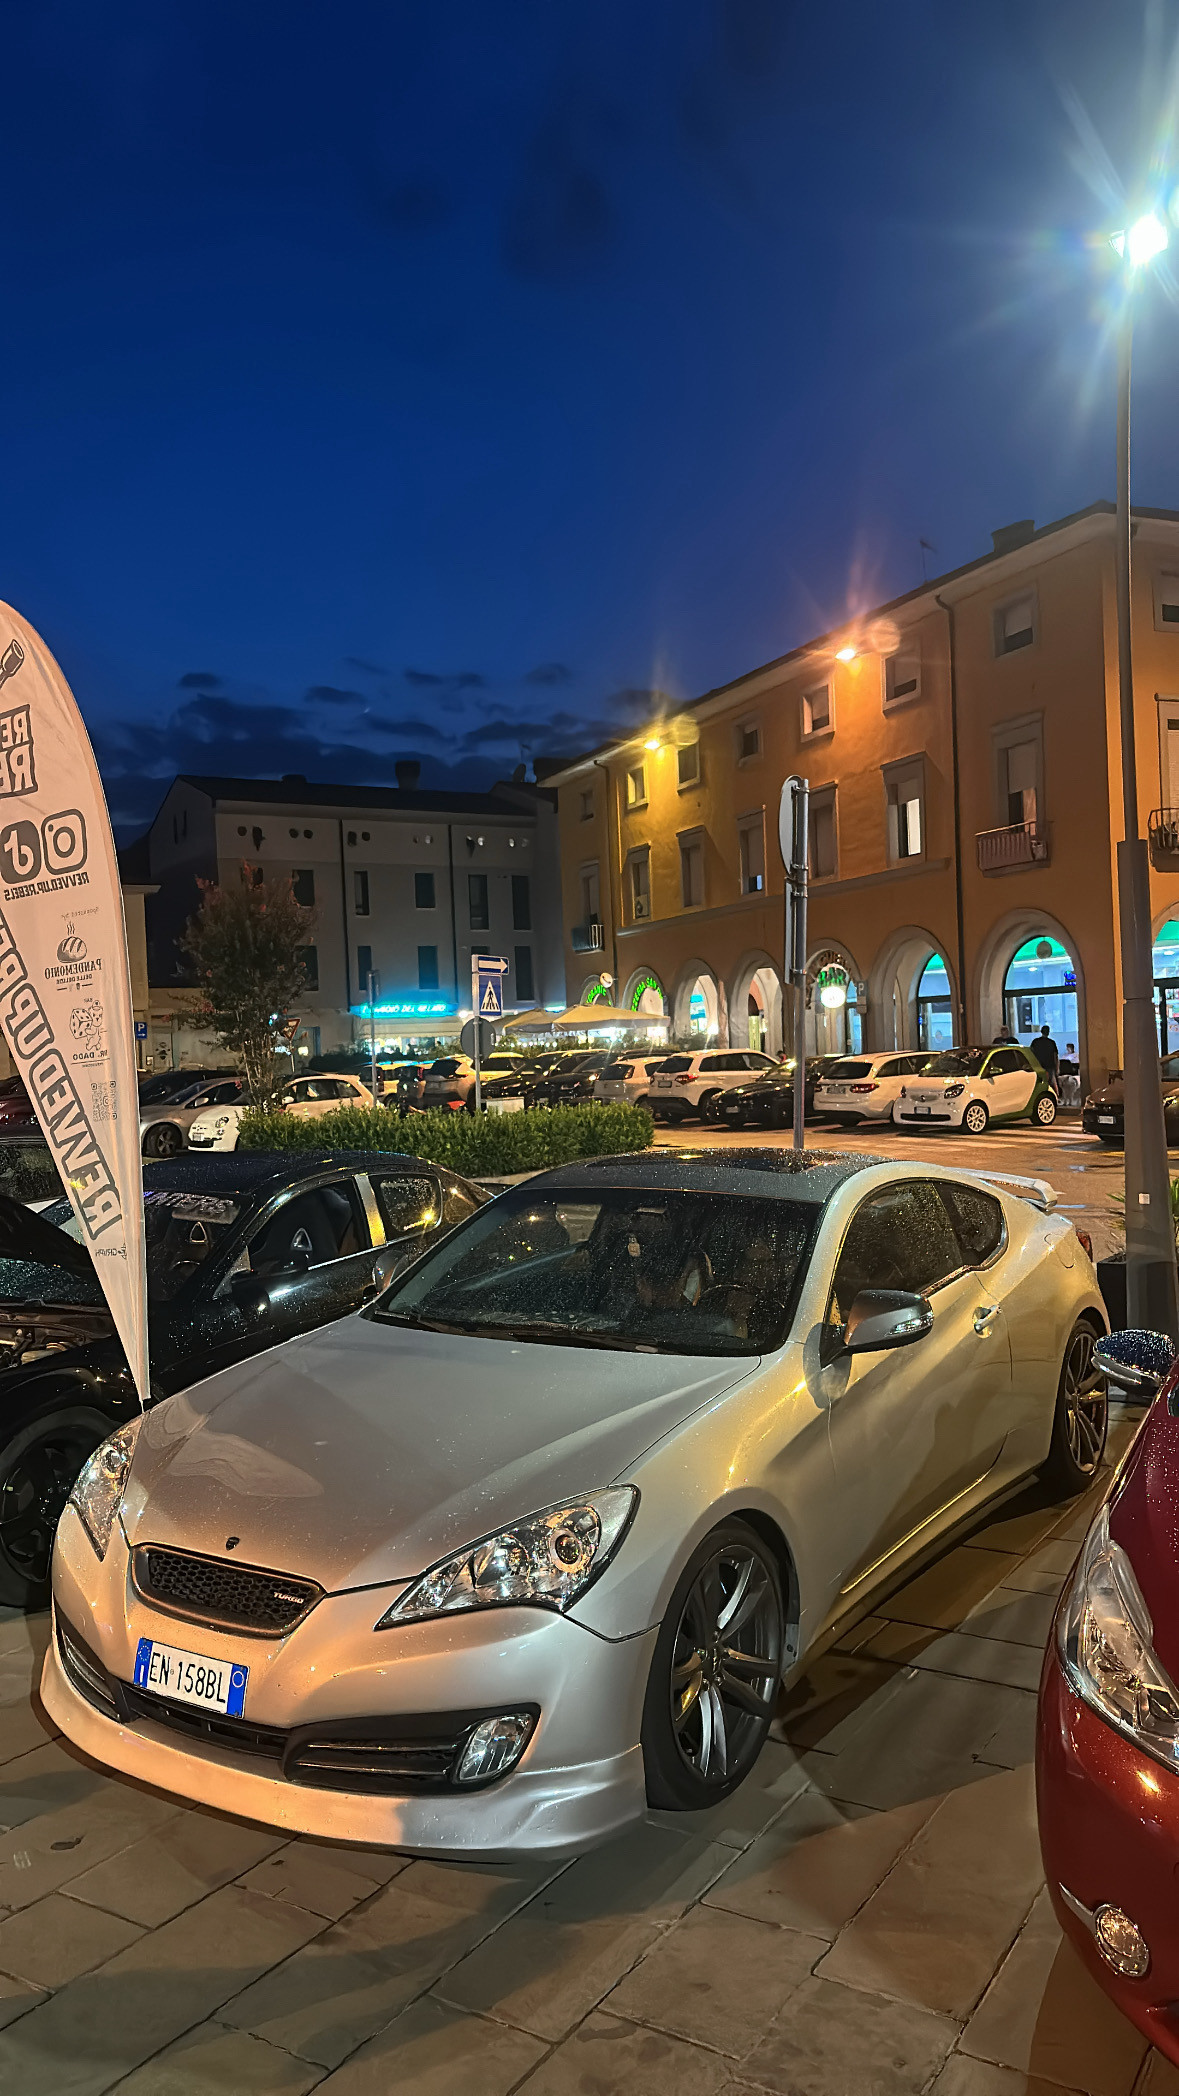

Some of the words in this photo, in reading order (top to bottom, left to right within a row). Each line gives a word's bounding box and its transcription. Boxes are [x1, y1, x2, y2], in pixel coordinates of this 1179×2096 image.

[137, 1022, 145, 1033] P
[149, 1652, 172, 1687] EN
[176, 1661, 226, 1704] 158BL
